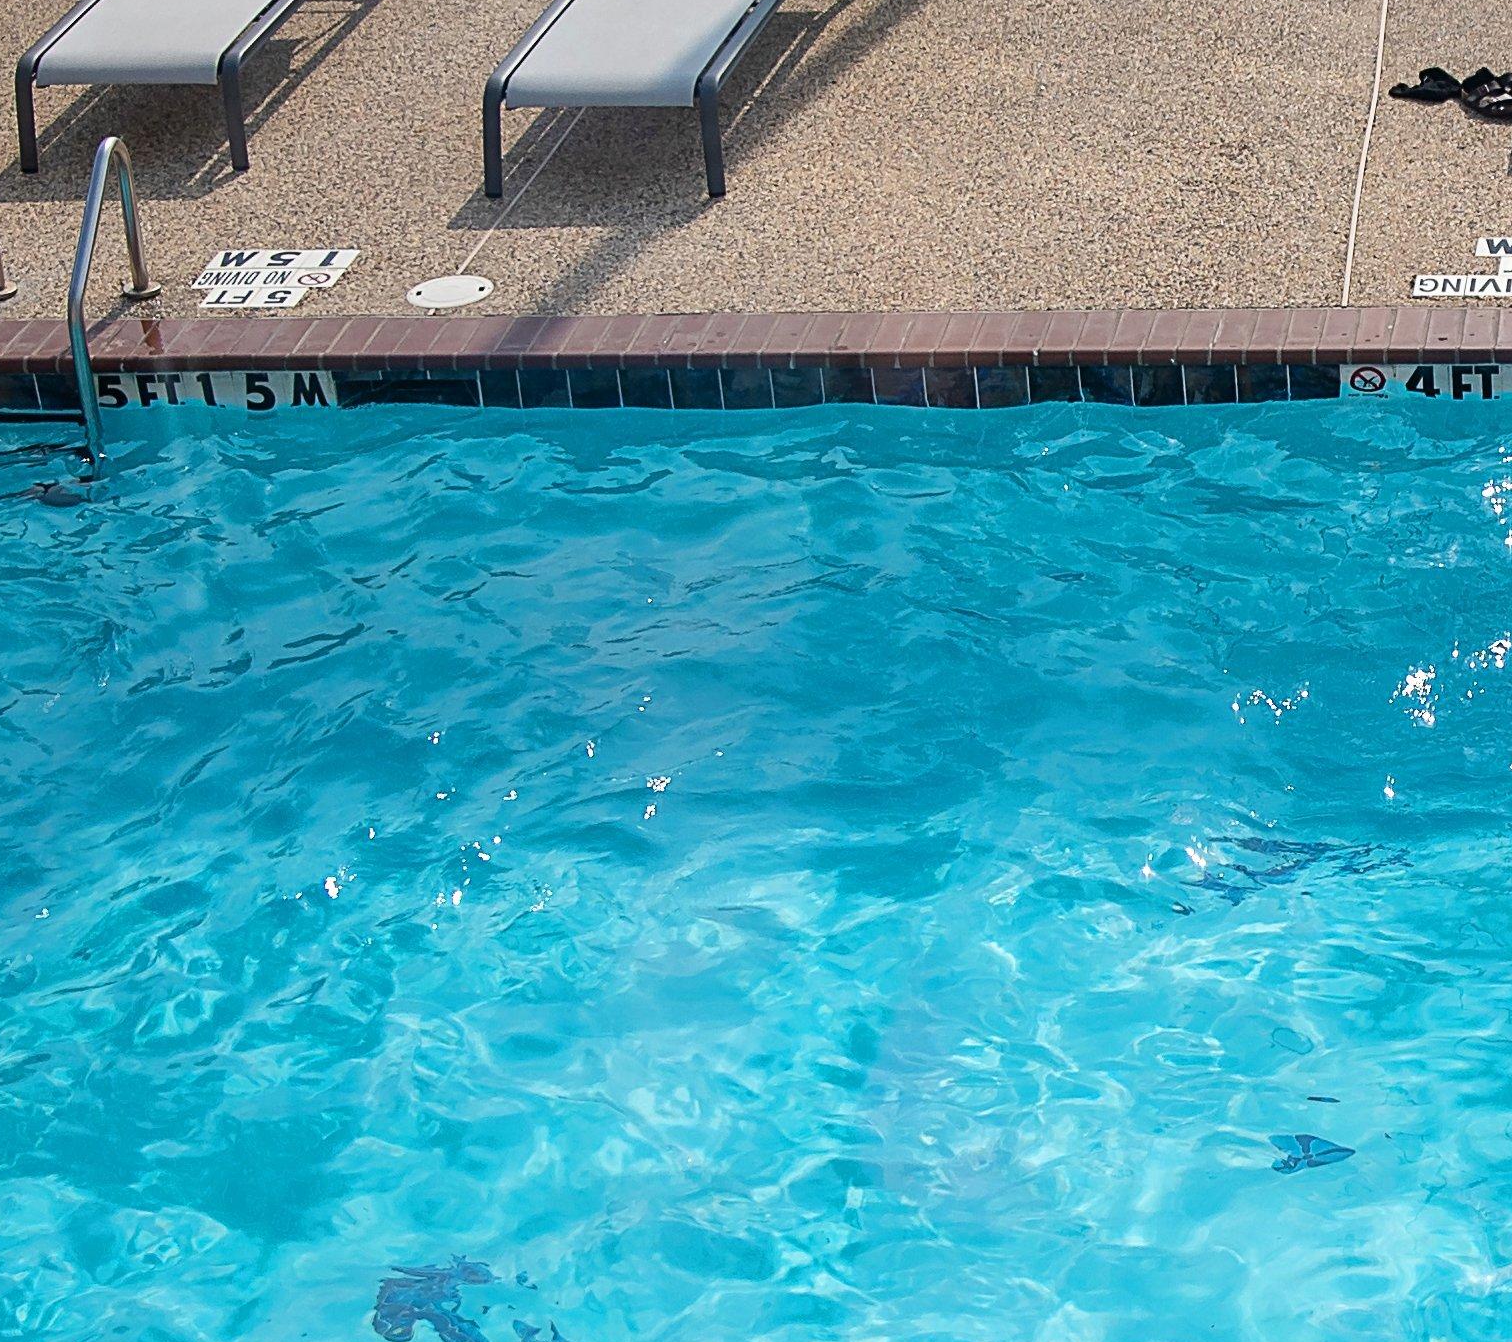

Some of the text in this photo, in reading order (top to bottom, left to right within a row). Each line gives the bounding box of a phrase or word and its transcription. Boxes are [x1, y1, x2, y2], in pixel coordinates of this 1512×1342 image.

[220, 251, 340, 266] 1 5 M
[198, 271, 292, 285] NO DIVING
[206, 290, 291, 304] 5 FT
[1406, 366, 1440, 398] 4
[98, 375, 128, 408] 5
[291, 372, 331, 408] M
